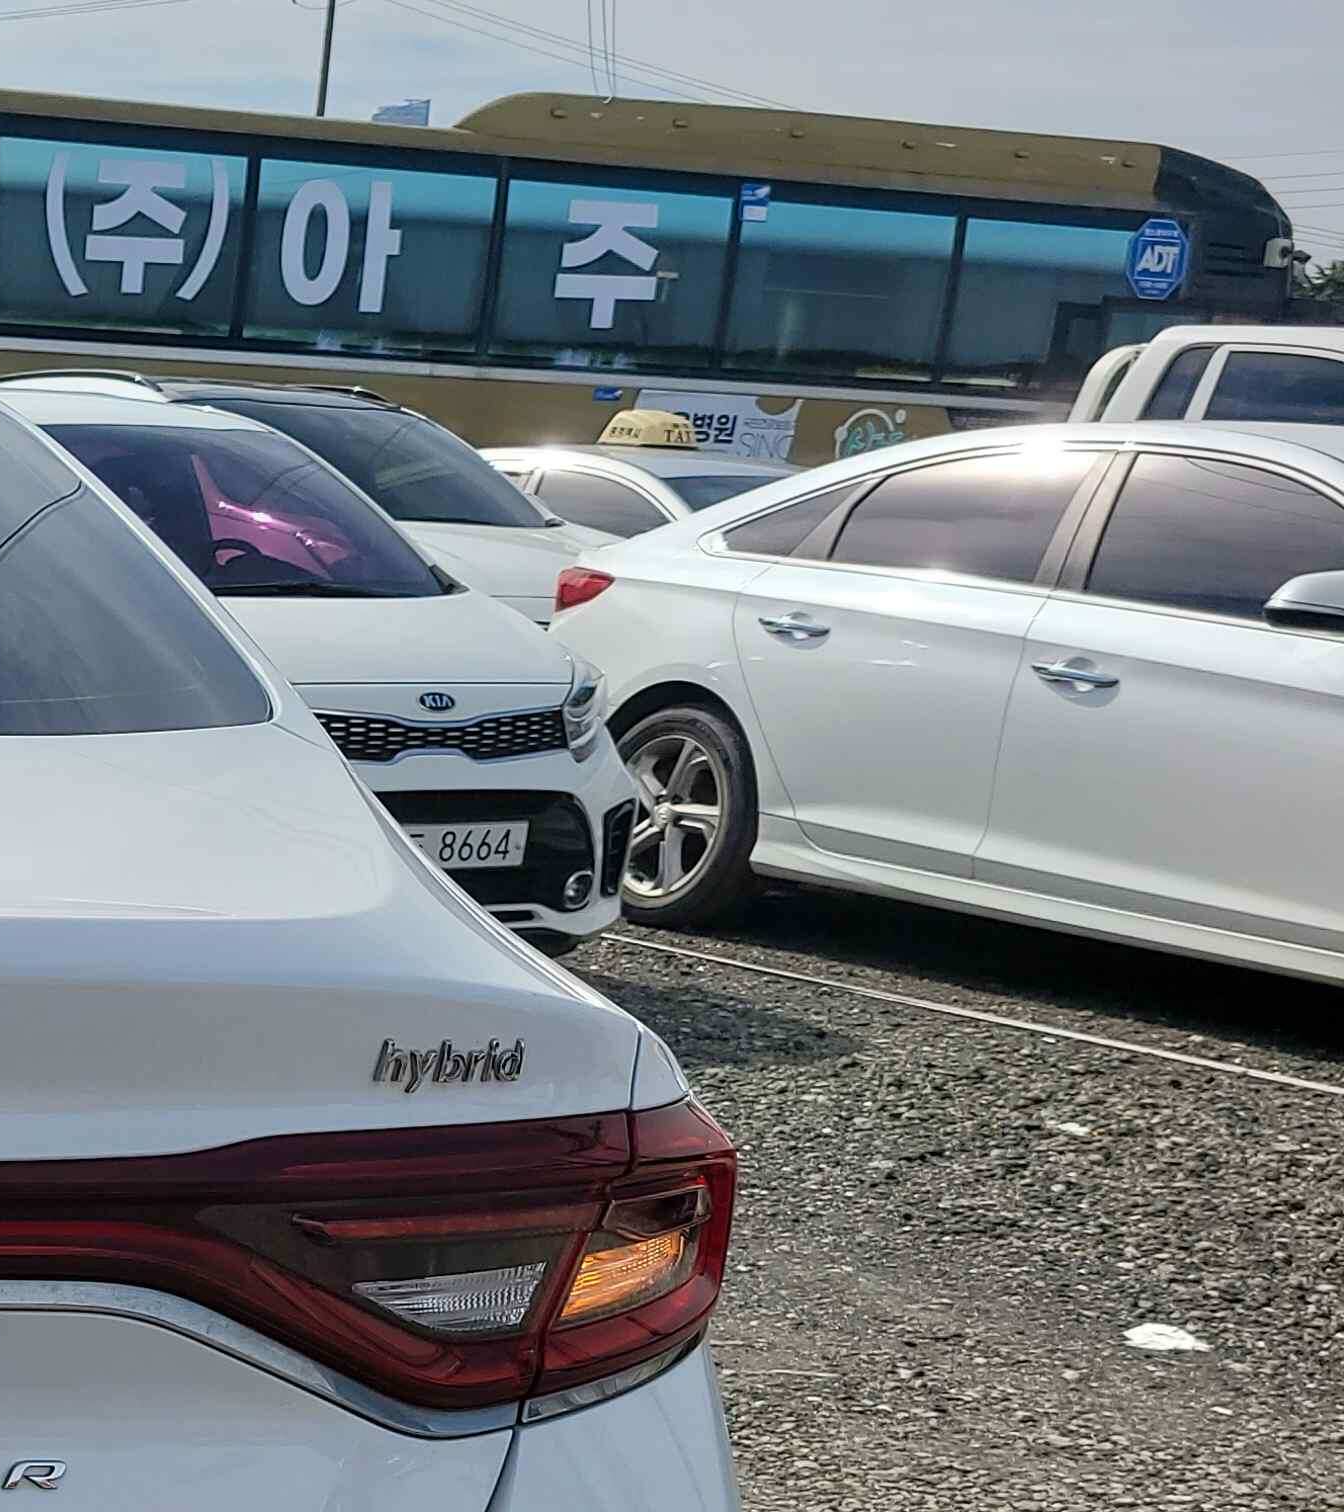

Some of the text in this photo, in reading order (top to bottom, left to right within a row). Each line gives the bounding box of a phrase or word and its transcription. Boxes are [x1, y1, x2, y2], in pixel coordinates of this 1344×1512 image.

[1135, 245, 1180, 273] ADT
[673, 412, 737, 443] 병원
[423, 693, 454, 708] KIA
[439, 829, 512, 862] 8664
[372, 1038, 526, 1094] hybrid
